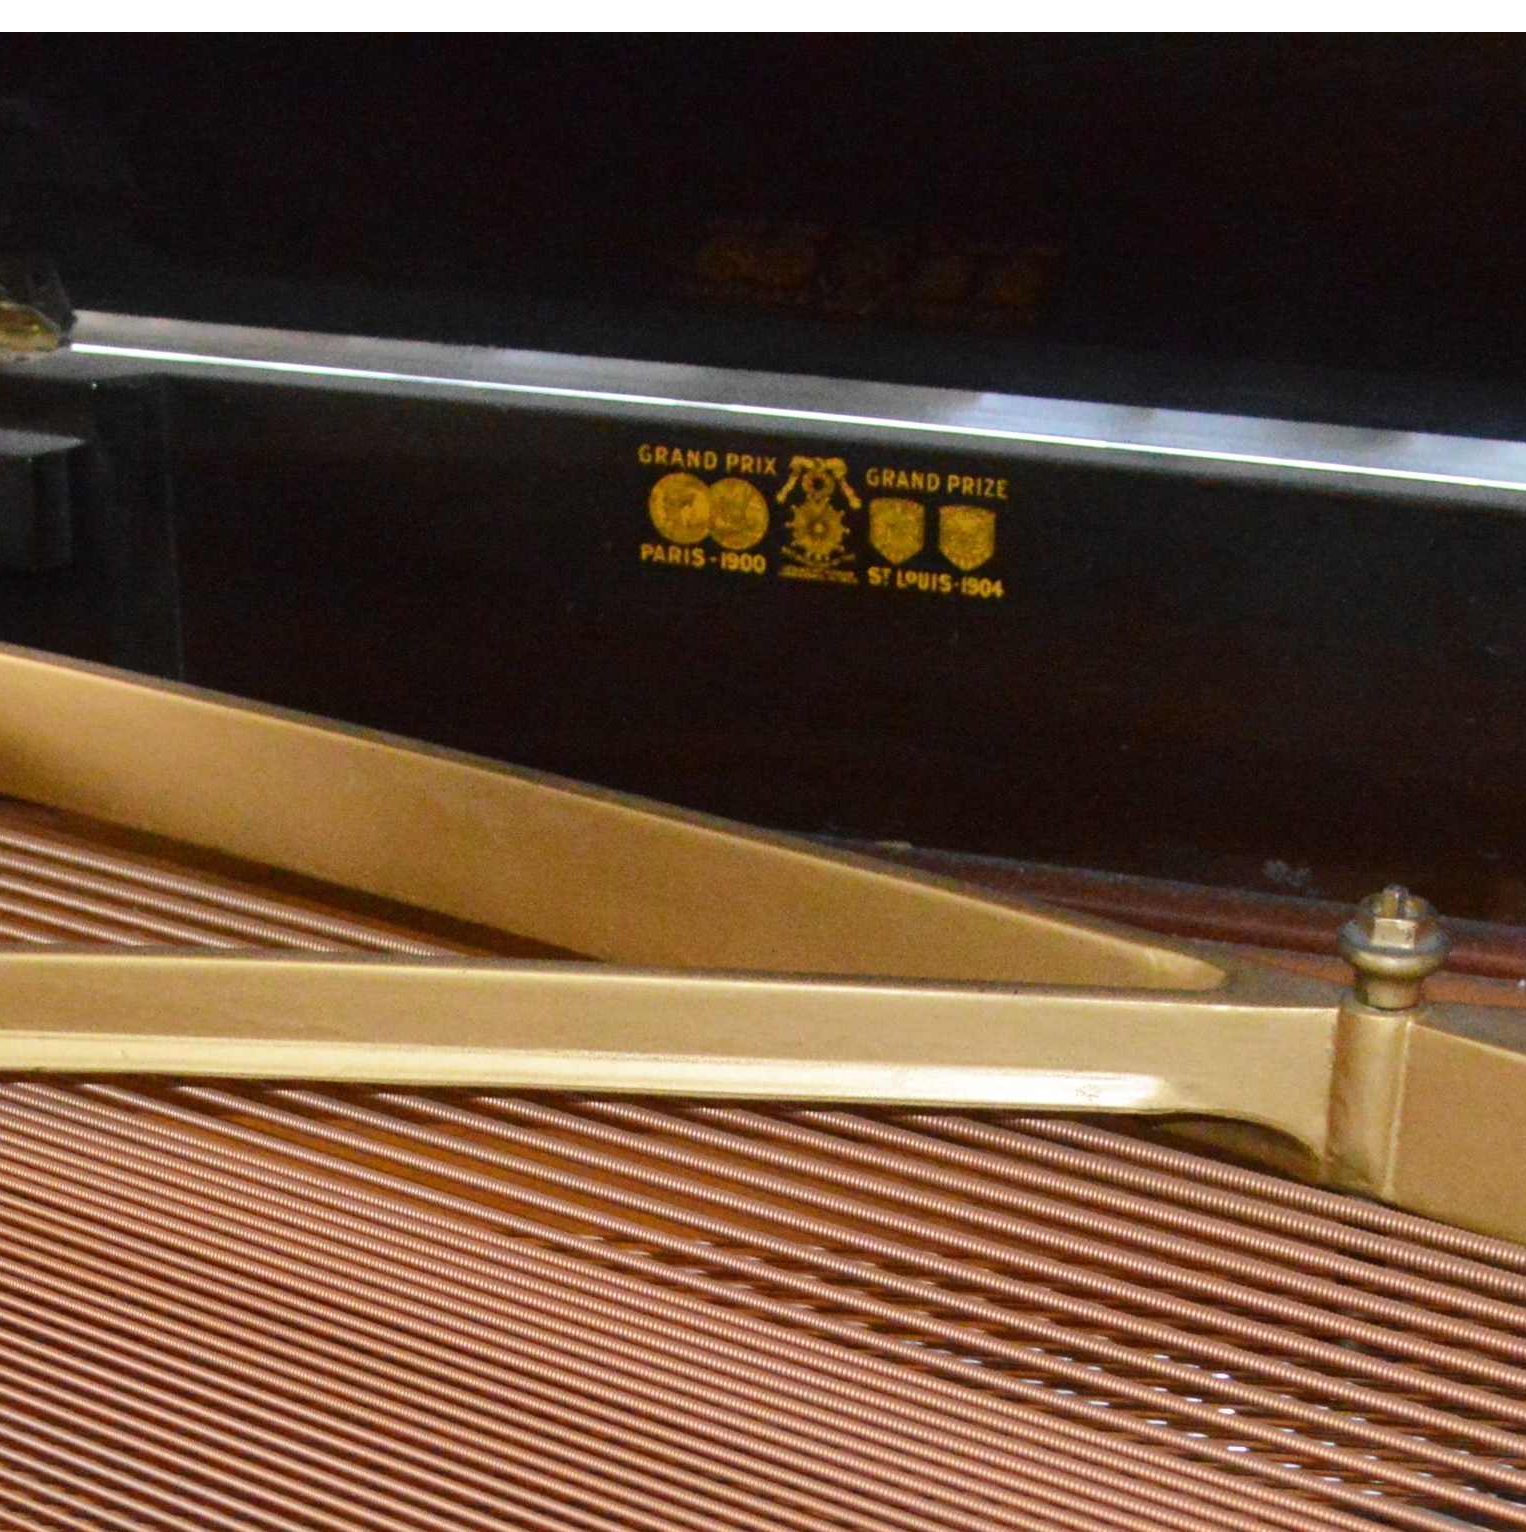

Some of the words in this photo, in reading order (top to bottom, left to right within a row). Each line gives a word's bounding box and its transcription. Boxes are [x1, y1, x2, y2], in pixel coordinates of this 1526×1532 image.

[637, 444, 719, 471] GRAND
[725, 452, 778, 477] PRIX
[866, 467, 941, 492] GRAND
[946, 473, 1009, 500] PRIZE
